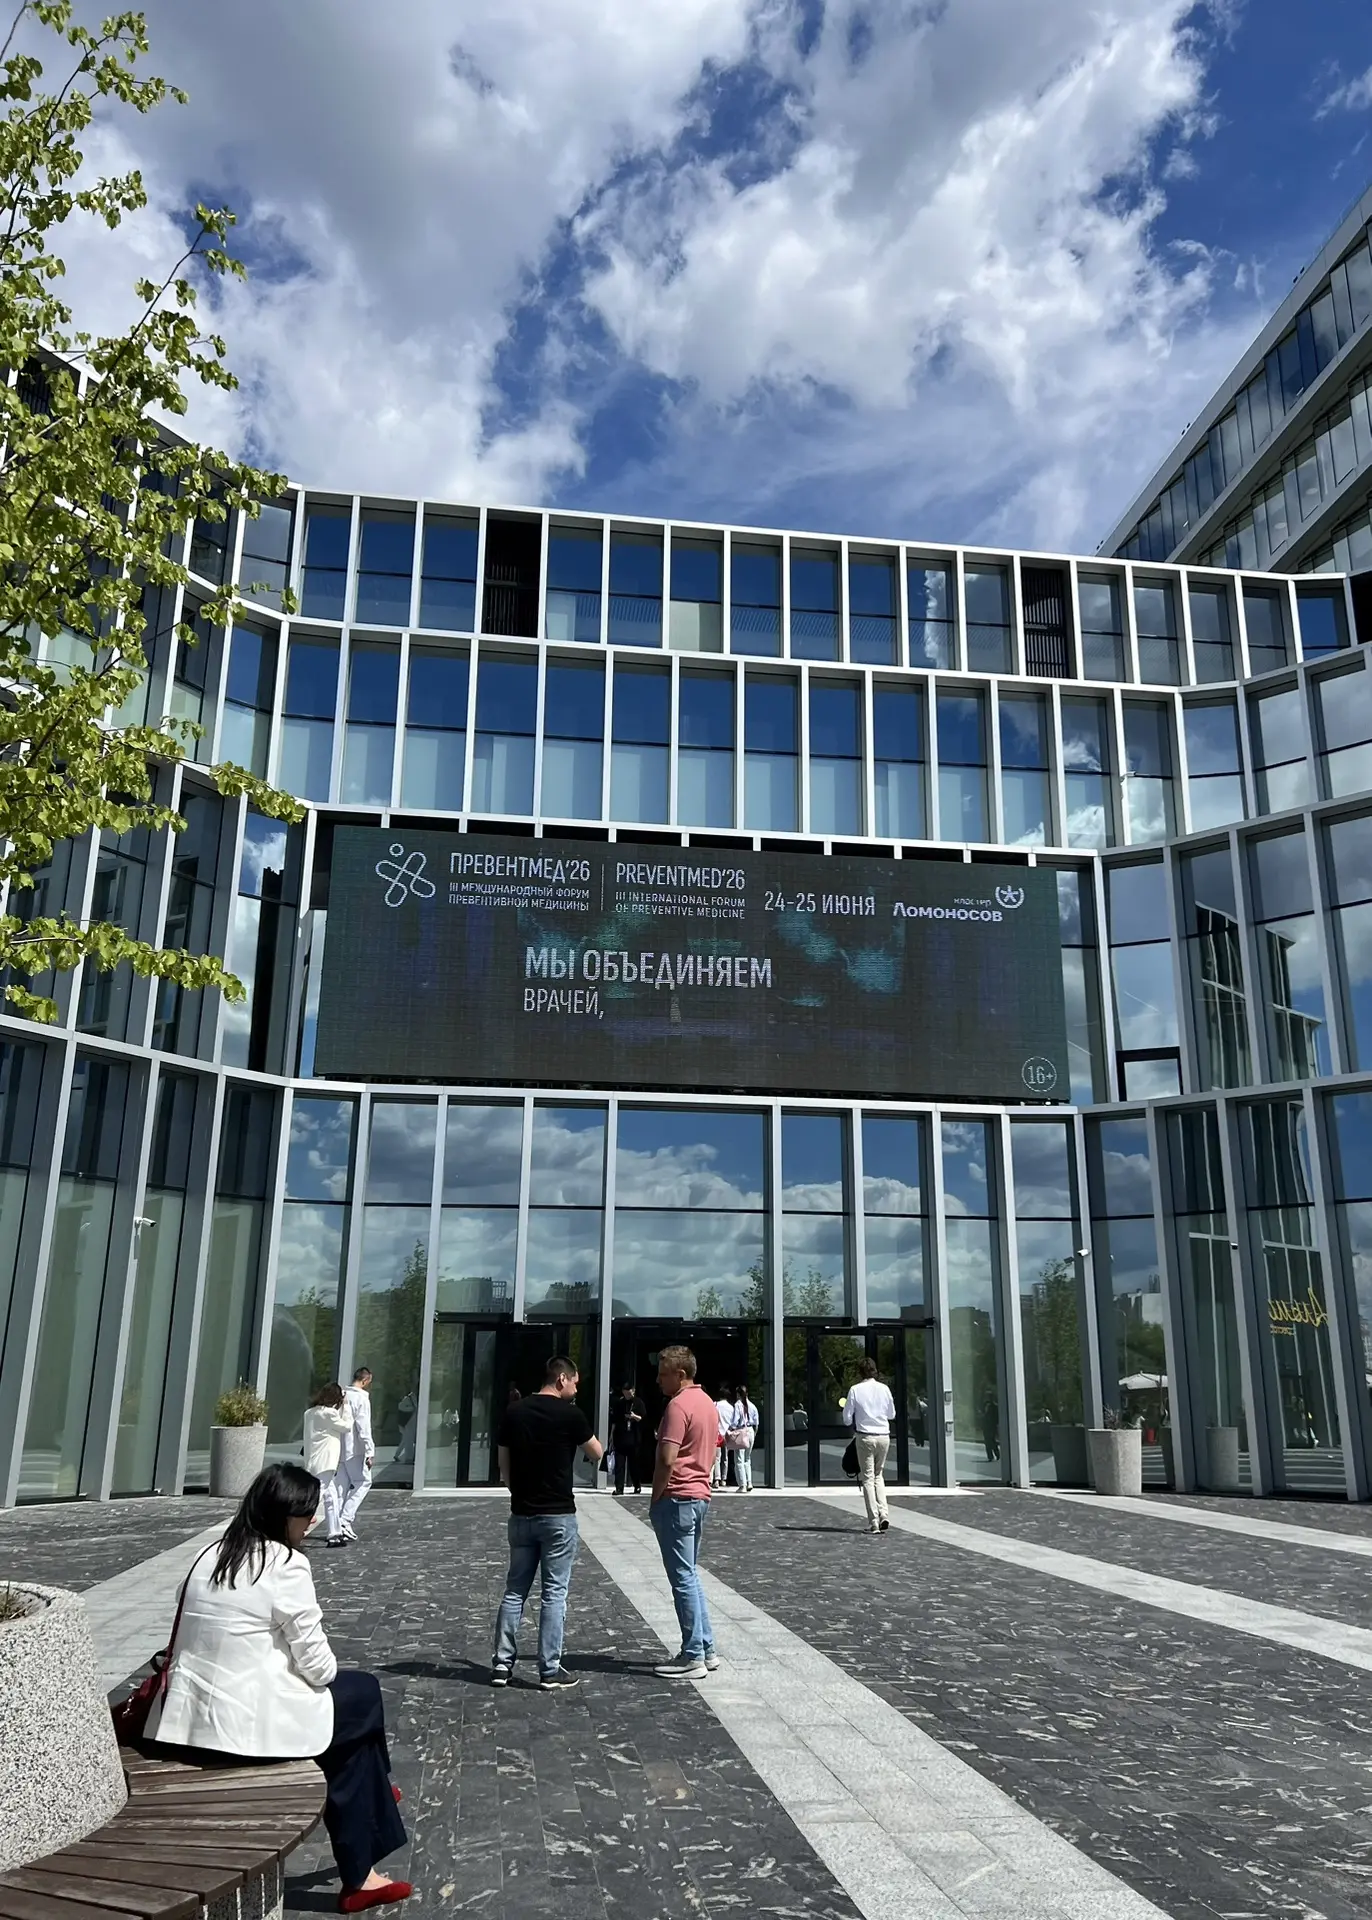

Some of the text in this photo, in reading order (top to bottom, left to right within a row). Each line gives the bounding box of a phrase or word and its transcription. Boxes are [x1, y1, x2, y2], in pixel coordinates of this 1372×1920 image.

[460, 882, 553, 897] МЕЖДУНАРОДНЫЙ
[555, 888, 590, 899] ФОРУМ
[615, 891, 746, 907] III INTERNATIONAL FORUM
[448, 893, 589, 911] ПРЕВЕНТИВНОЙ МЕДИЦИНЫ
[615, 902, 746, 920] OF PREVENTIVE MEDICINE
[764, 890, 876, 916] 24-25 ИЮНЯ
[524, 946, 773, 990] МЫ ОБЪЕДИНЯЕМ
[523, 986, 604, 1020] ВРАЧЕЙ,
[1028, 1065, 1054, 1084] 16+
